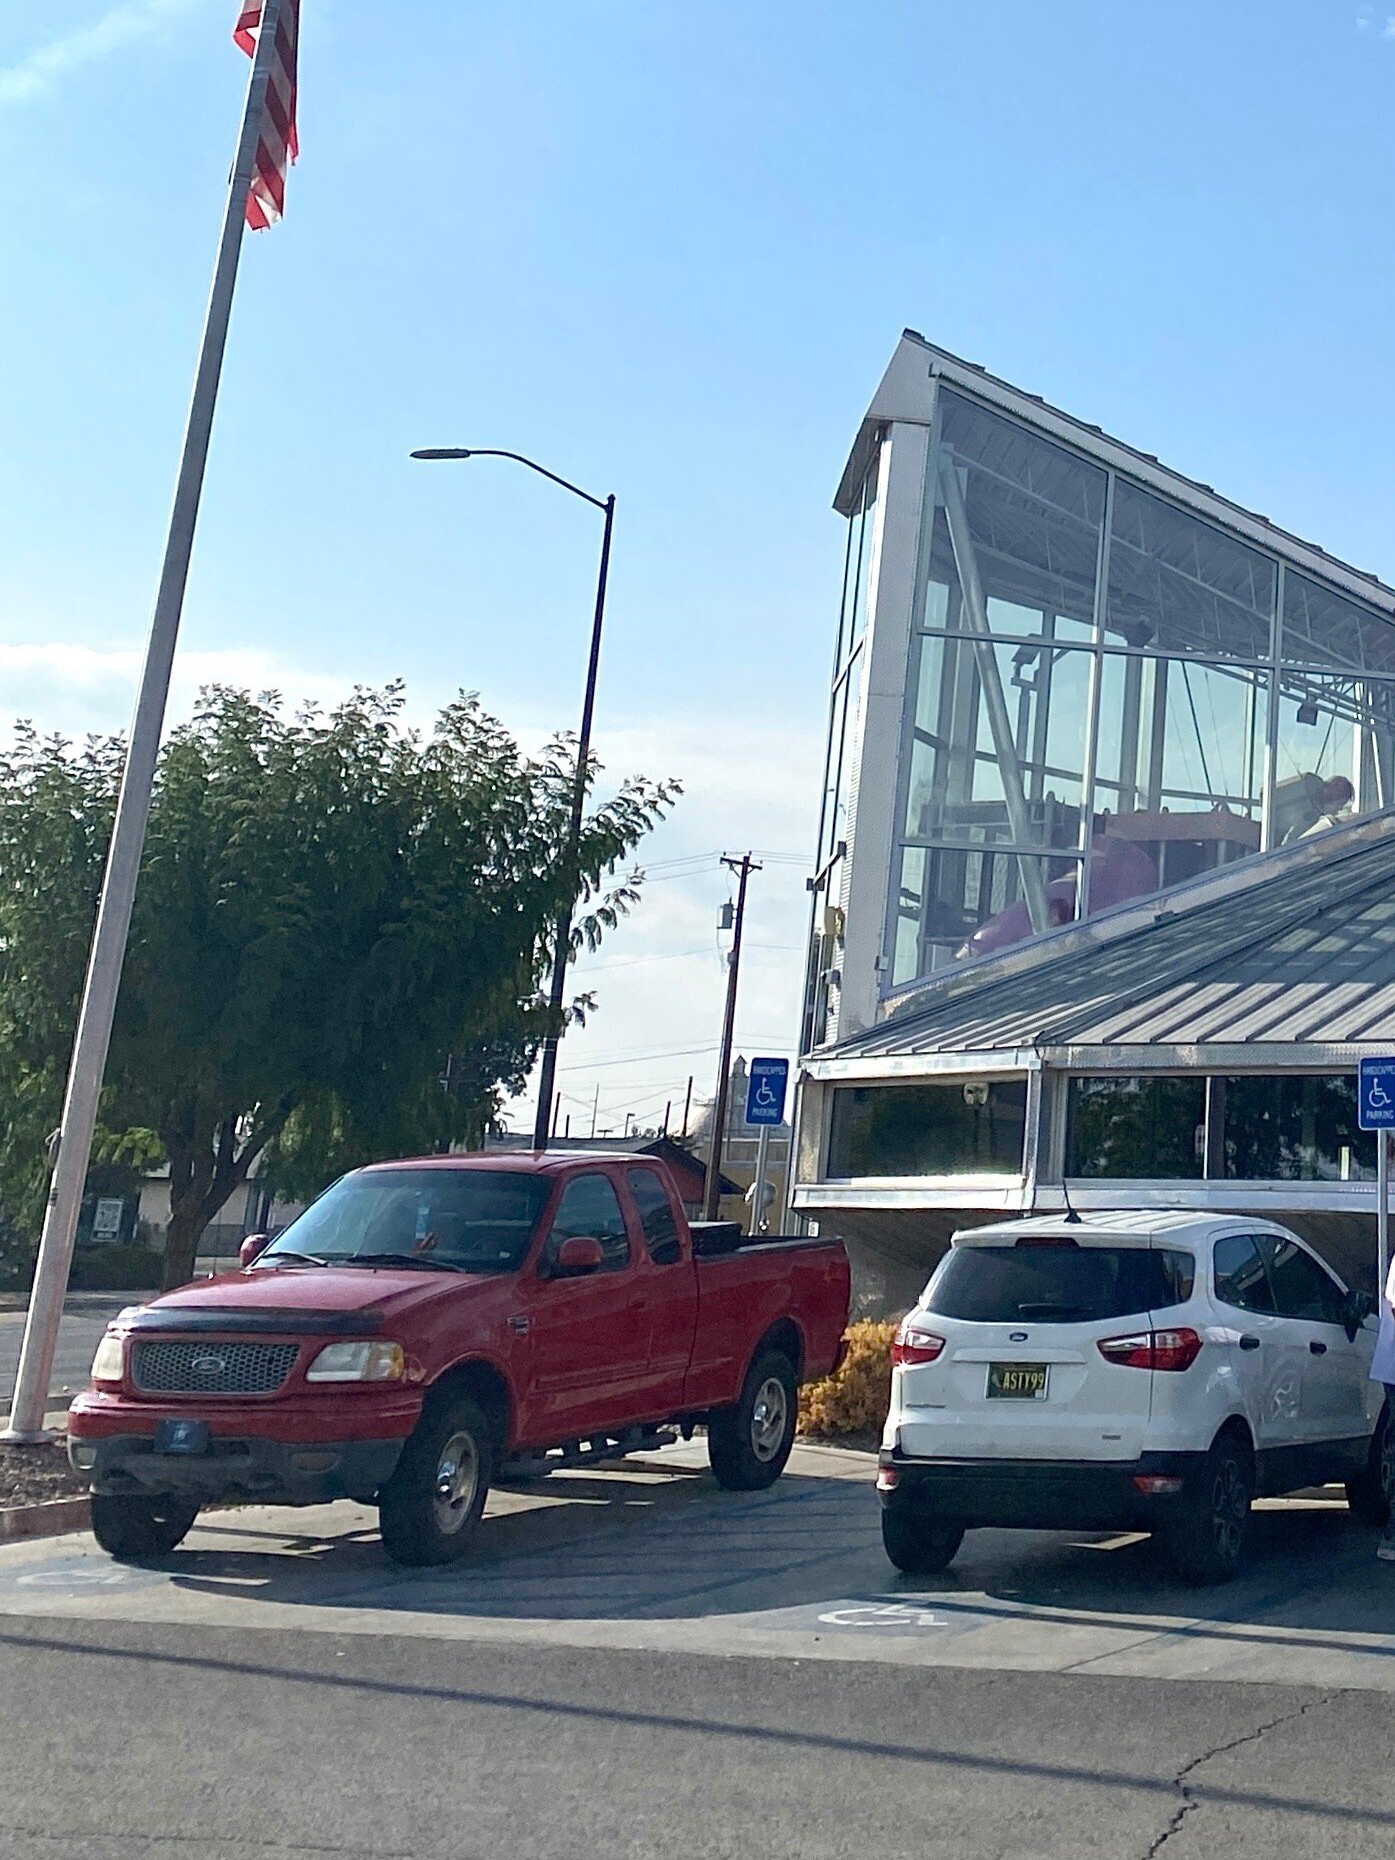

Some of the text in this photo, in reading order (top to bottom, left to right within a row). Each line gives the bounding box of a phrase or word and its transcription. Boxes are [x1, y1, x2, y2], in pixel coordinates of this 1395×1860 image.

[752, 1066, 786, 1075] HANDICAPPED
[752, 1107, 778, 1117] PARKING
[1366, 1110, 1394, 1120] PARKING
[1003, 1372, 1044, 1390] ASTY99
